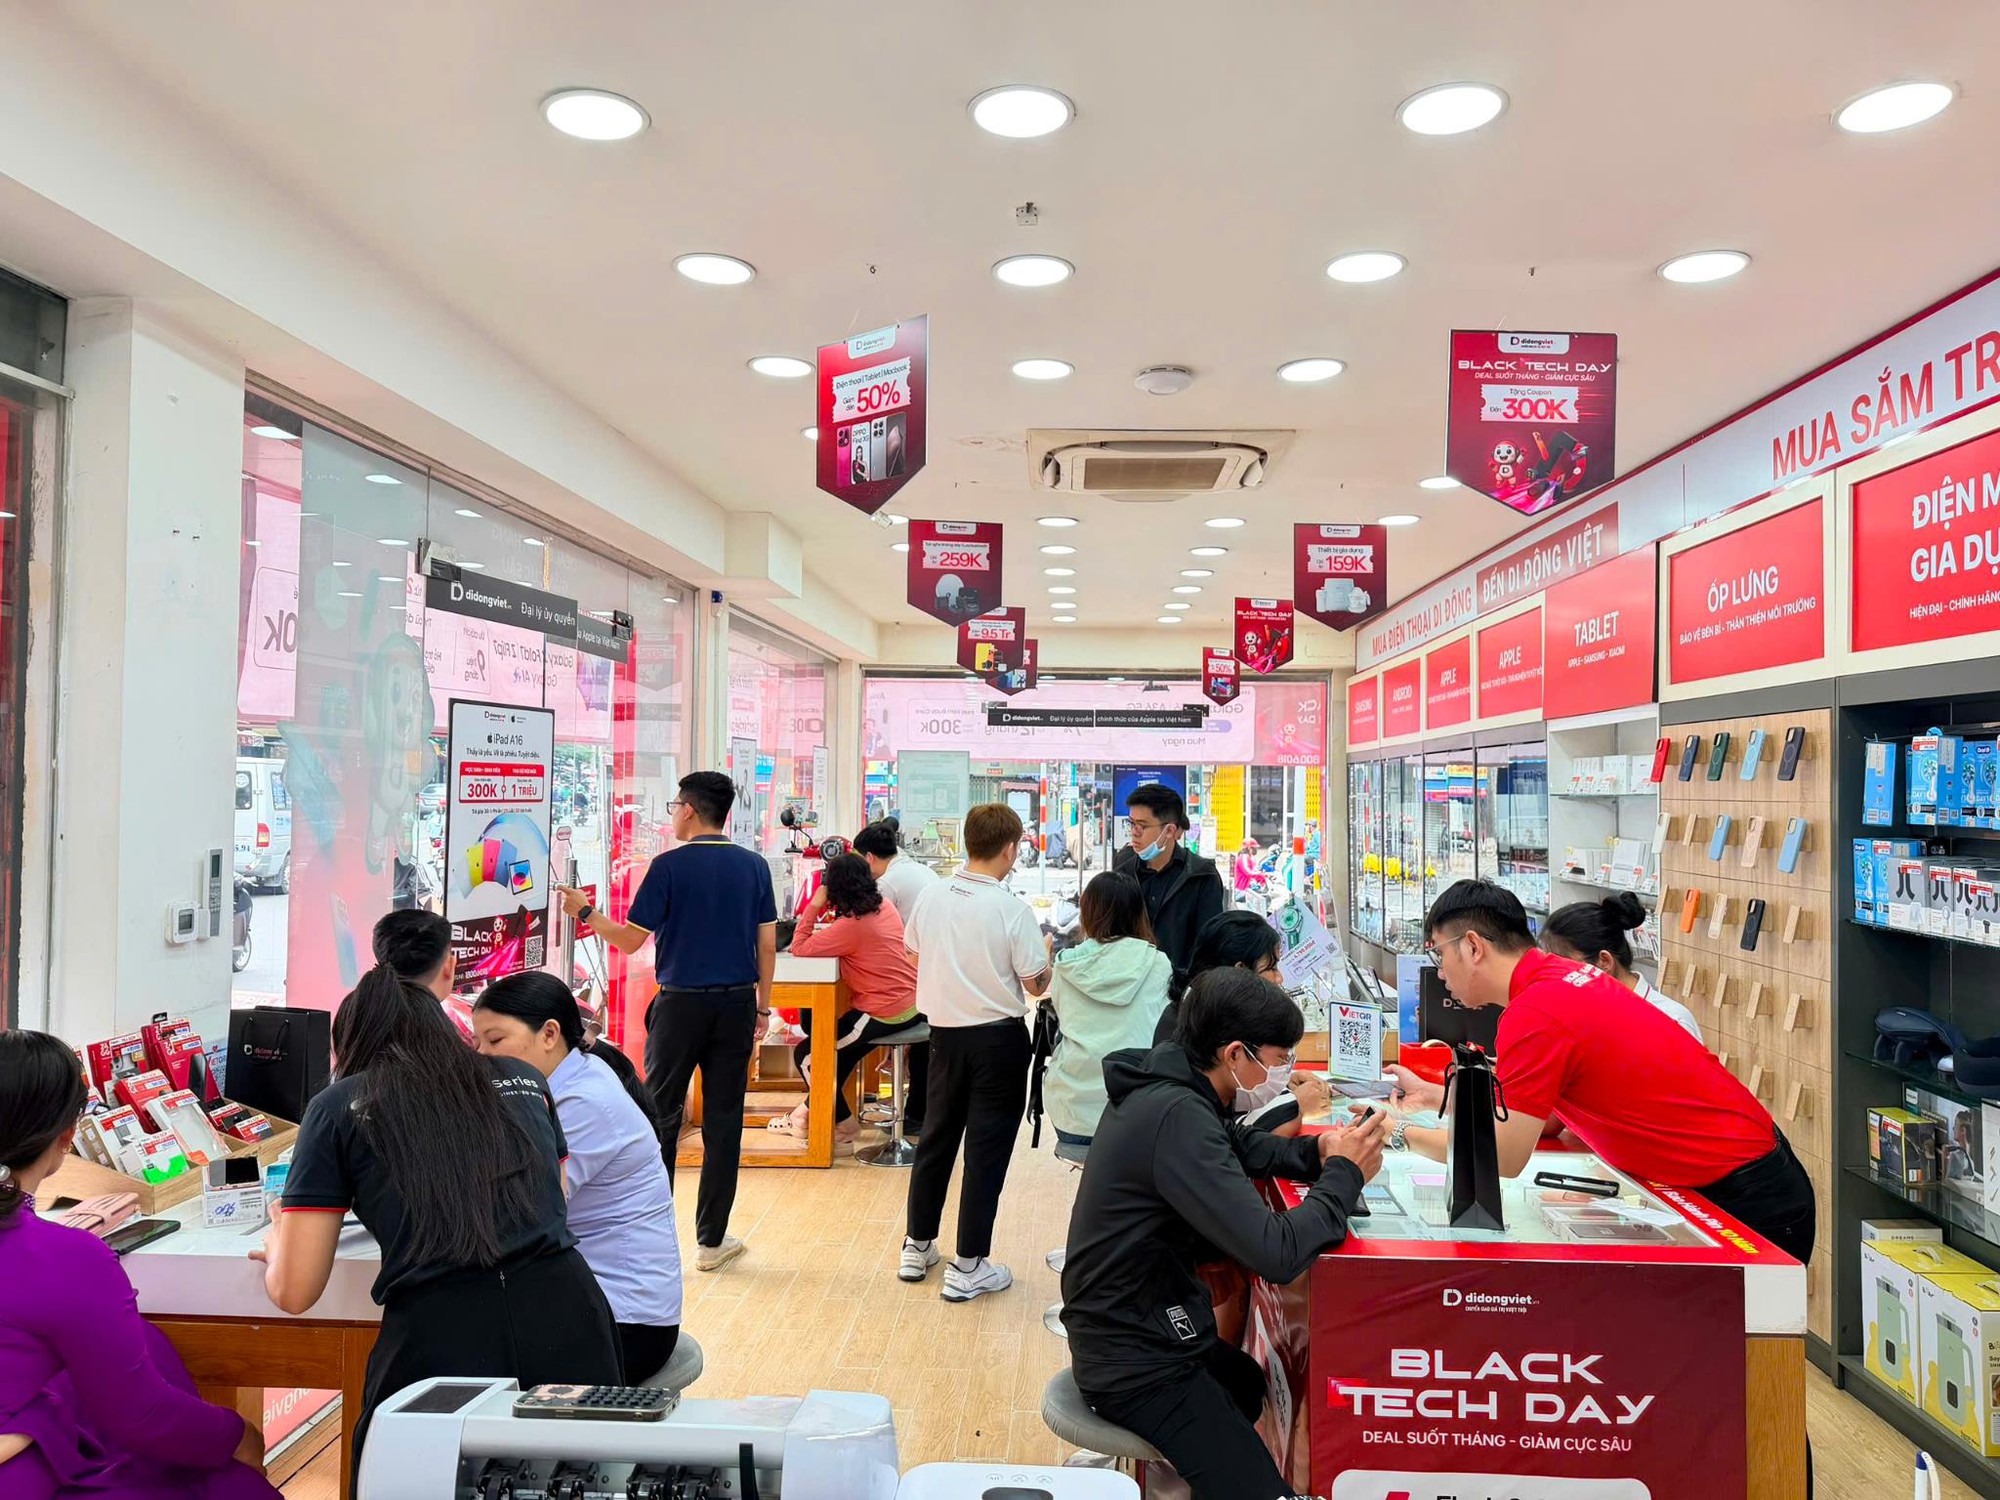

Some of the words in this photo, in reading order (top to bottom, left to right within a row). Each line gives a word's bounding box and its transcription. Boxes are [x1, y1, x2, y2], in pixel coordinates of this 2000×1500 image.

[1458, 359, 1517, 371] BLACK
[1522, 361, 1569, 372] TECH
[1575, 363, 1612, 373] DAY
[1495, 371, 1514, 379] SUỐT
[1515, 372, 1540, 380] THÁNG
[1545, 373, 1563, 381] GIẢM
[1564, 374, 1579, 382] CỰC
[1580, 374, 1595, 382] SÂU
[857, 379, 901, 413] 50%
[1527, 388, 1552, 396] Coupon
[1502, 398, 1569, 420] 300K
[1772, 411, 1842, 481] MUA
[1850, 365, 1933, 444] SẮM
[1912, 475, 1976, 530] ĐIỆN
[939, 551, 982, 568] 259K
[1325, 555, 1367, 571] 159K
[1483, 567, 1505, 604] ĐẾN
[1508, 563, 1520, 593] DI
[1523, 544, 1561, 588] ĐỘNG
[1566, 522, 1604, 568] VIỆT
[1910, 540, 1957, 582] GIA
[1707, 578, 1729, 613] ỐP
[1732, 565, 1779, 605] LƯNG
[520, 601, 535, 617] Đại
[535, 603, 543, 620] lý
[544, 607, 553, 623] ủy
[554, 611, 576, 628] quyền
[1909, 604, 1928, 620] HIỆN
[1928, 602, 1943, 616] ĐẠI
[1948, 595, 1976, 611] CHÍNH
[1372, 634, 1388, 657] MUA
[1407, 608, 1431, 640] THOẠI
[1433, 602, 1442, 628] DI
[1444, 586, 1472, 624] ĐỘNG
[1574, 610, 1620, 647] TABLET
[981, 628, 998, 639] 9.5
[999, 628, 1011, 639] Tr
[1499, 645, 1522, 669] APPLE
[1440, 667, 1457, 687] APPLE
[1097, 715, 1113, 723] chính
[1139, 716, 1155, 724] Apple
[493, 732, 509, 745] iPad
[509, 735, 524, 746] A16
[467, 783, 498, 798] 300K
[518, 784, 537, 797] TRIỆU
[451, 924, 492, 943] BLACK
[451, 946, 480, 959] TECH
[491, 1075, 539, 1089] Series
[1390, 1348, 1604, 1384] BLACK
[1338, 1386, 1498, 1420] TECH
[1526, 1394, 1655, 1424] DAY
[1362, 1430, 1404, 1444] DEAL
[1406, 1426, 1449, 1446] SUỐT
[1452, 1429, 1506, 1448] THÁNG
[1519, 1432, 1561, 1450] GIẢM
[1563, 1437, 1598, 1453] CỰC
[1600, 1436, 1632, 1451] SÂU
